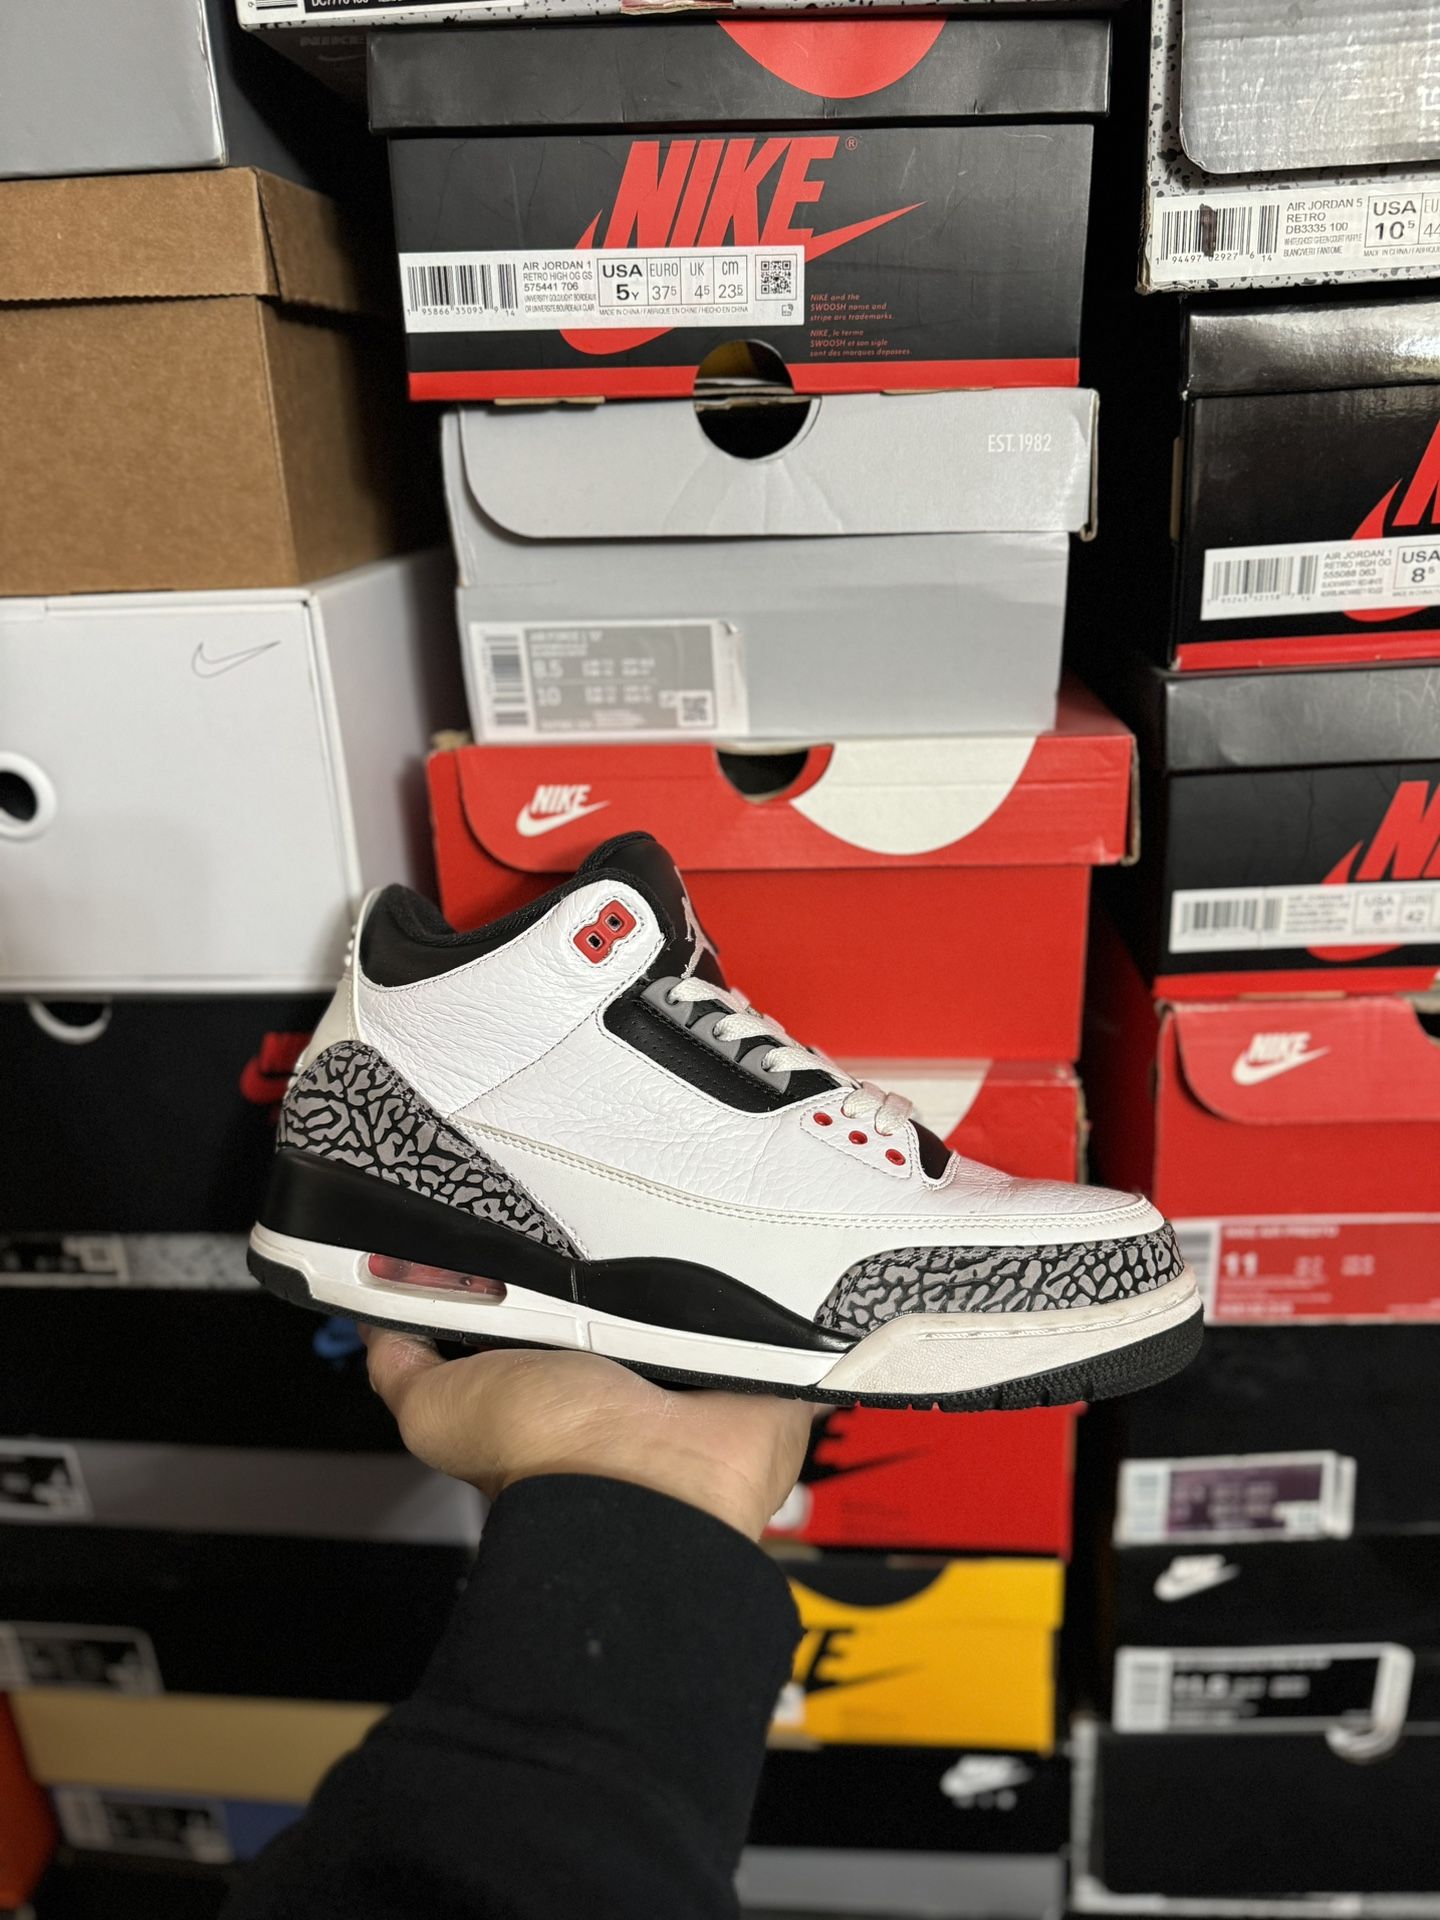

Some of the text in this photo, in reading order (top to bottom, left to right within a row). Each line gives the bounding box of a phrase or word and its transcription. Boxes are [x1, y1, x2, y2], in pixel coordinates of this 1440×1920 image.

[602, 136, 840, 248] NIKE
[1286, 198, 1363, 212] AIR JORDAN 5
[1373, 200, 1417, 216] USA
[1286, 212, 1327, 223] RETRO
[1285, 222, 1349, 235] DB3335 100
[1172, 254, 1202, 264] 94497
[522, 261, 540, 271] AIR
[542, 260, 584, 271] JORDAN
[602, 263, 643, 278] USA
[649, 262, 679, 277] EURO
[690, 261, 705, 276] UK
[523, 271, 593, 282] RETRO HIGH OG GS
[524, 281, 579, 292] 575441 706
[810, 294, 829, 302] NIKE
[847, 293, 860, 301] the
[422, 307, 450, 316] 95866
[455, 306, 484, 315] 35093
[600, 308, 615, 316] MADE
[622, 308, 640, 316] CHINA
[810, 302, 847, 312] SWOOSH
[871, 302, 887, 311] and
[810, 314, 833, 323] stripe
[810, 339, 846, 348] SWOOSH
[870, 338, 889, 348] sigle
[810, 349, 827, 357] sont
[827, 349, 841, 357] des
[842, 349, 876, 358] marques
[1325, 551, 1341, 561] AIR
[1343, 549, 1385, 560] JORDAN
[1402, 550, 1440, 564] USA
[1324, 560, 1353, 570] RETRO
[1354, 559, 1377, 569] HIGH
[530, 784, 592, 814] NIKE
